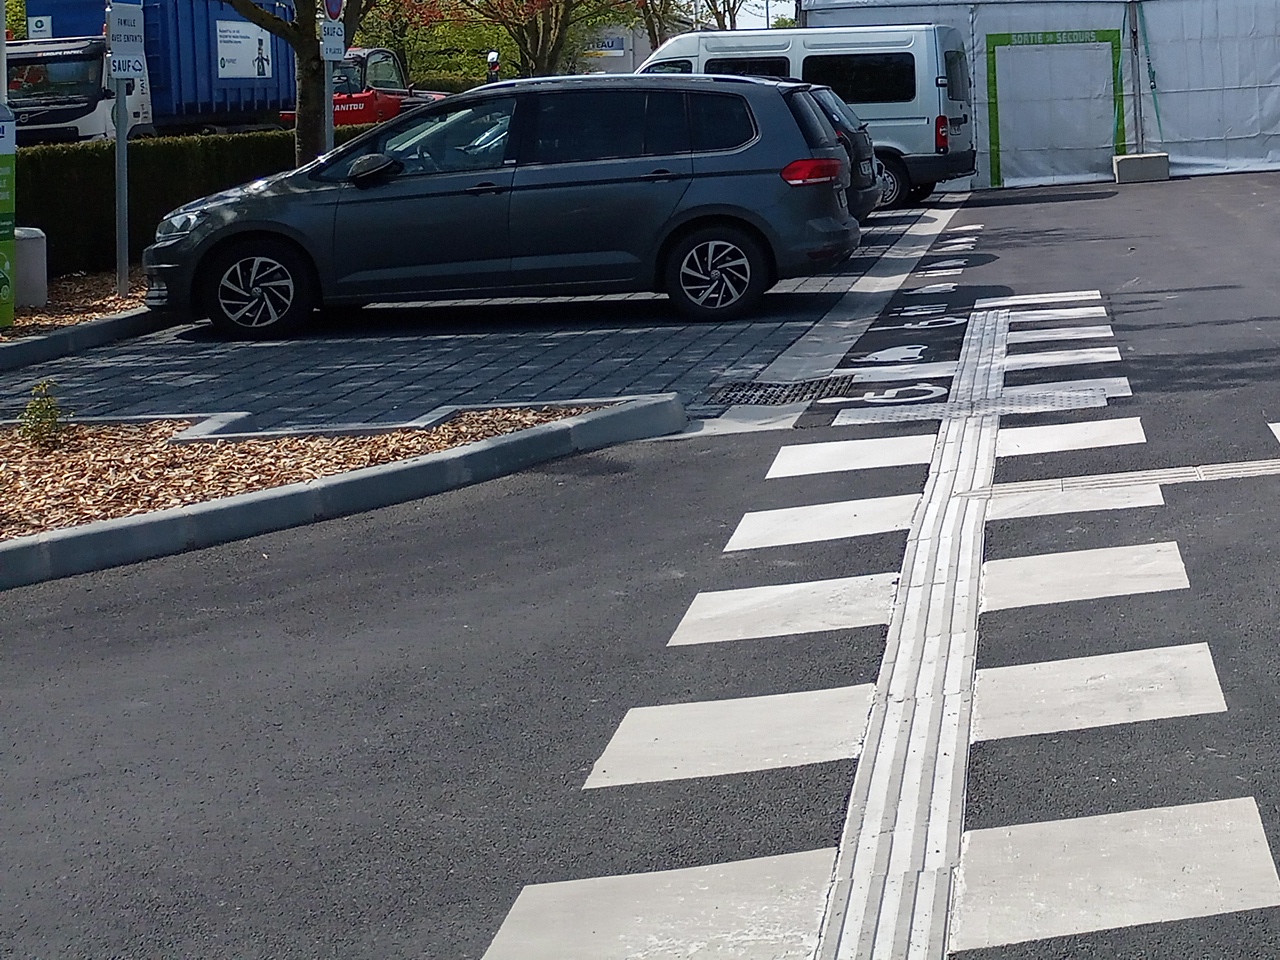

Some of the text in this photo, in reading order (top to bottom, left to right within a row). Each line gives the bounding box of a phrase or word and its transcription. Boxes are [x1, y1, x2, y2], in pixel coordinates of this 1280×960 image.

[323, 26, 337, 37] SAUF
[1012, 33, 1043, 45] SORTIE
[1056, 31, 1097, 43] SECOURS
[112, 59, 132, 73] SAUF
[333, 103, 365, 112] ANITOU
